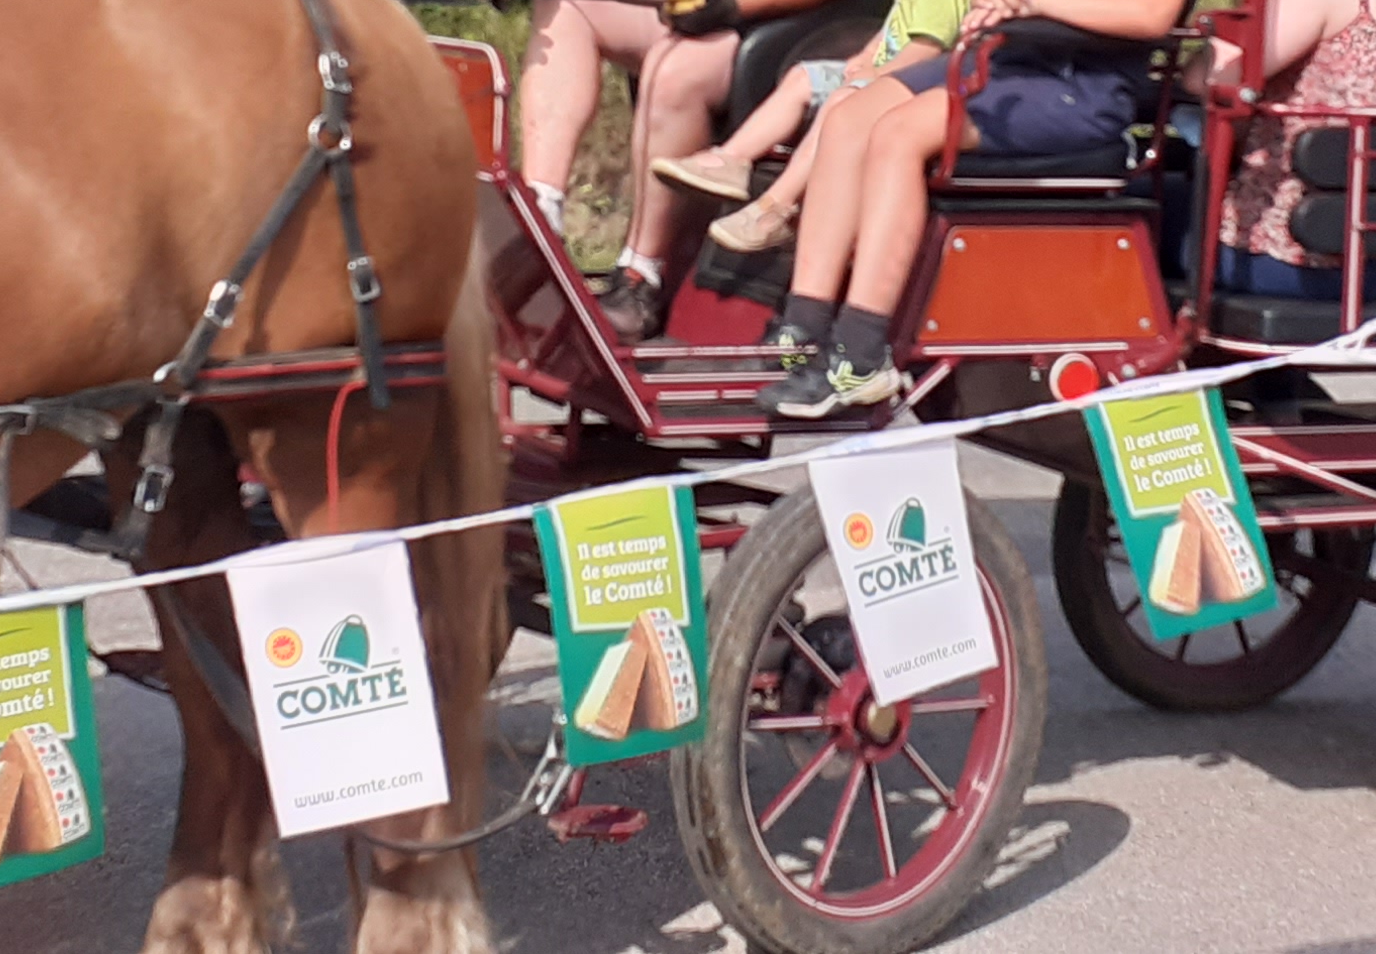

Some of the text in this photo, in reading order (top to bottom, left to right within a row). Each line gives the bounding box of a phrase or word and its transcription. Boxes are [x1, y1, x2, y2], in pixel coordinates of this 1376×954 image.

[1123, 423, 1200, 452] Il est temps
[1130, 441, 1205, 471] de savourer
[1133, 474, 1152, 493] le
[1151, 458, 1203, 489] Comté
[577, 535, 667, 561] Il est temps
[581, 556, 670, 582] de savourer
[858, 543, 957, 597] COMTÉ
[584, 586, 602, 606] le
[605, 573, 664, 603] Comté
[883, 638, 977, 679] www.comte.com
[276, 666, 407, 720] COMTÉ
[293, 770, 424, 809] www.comte.com
